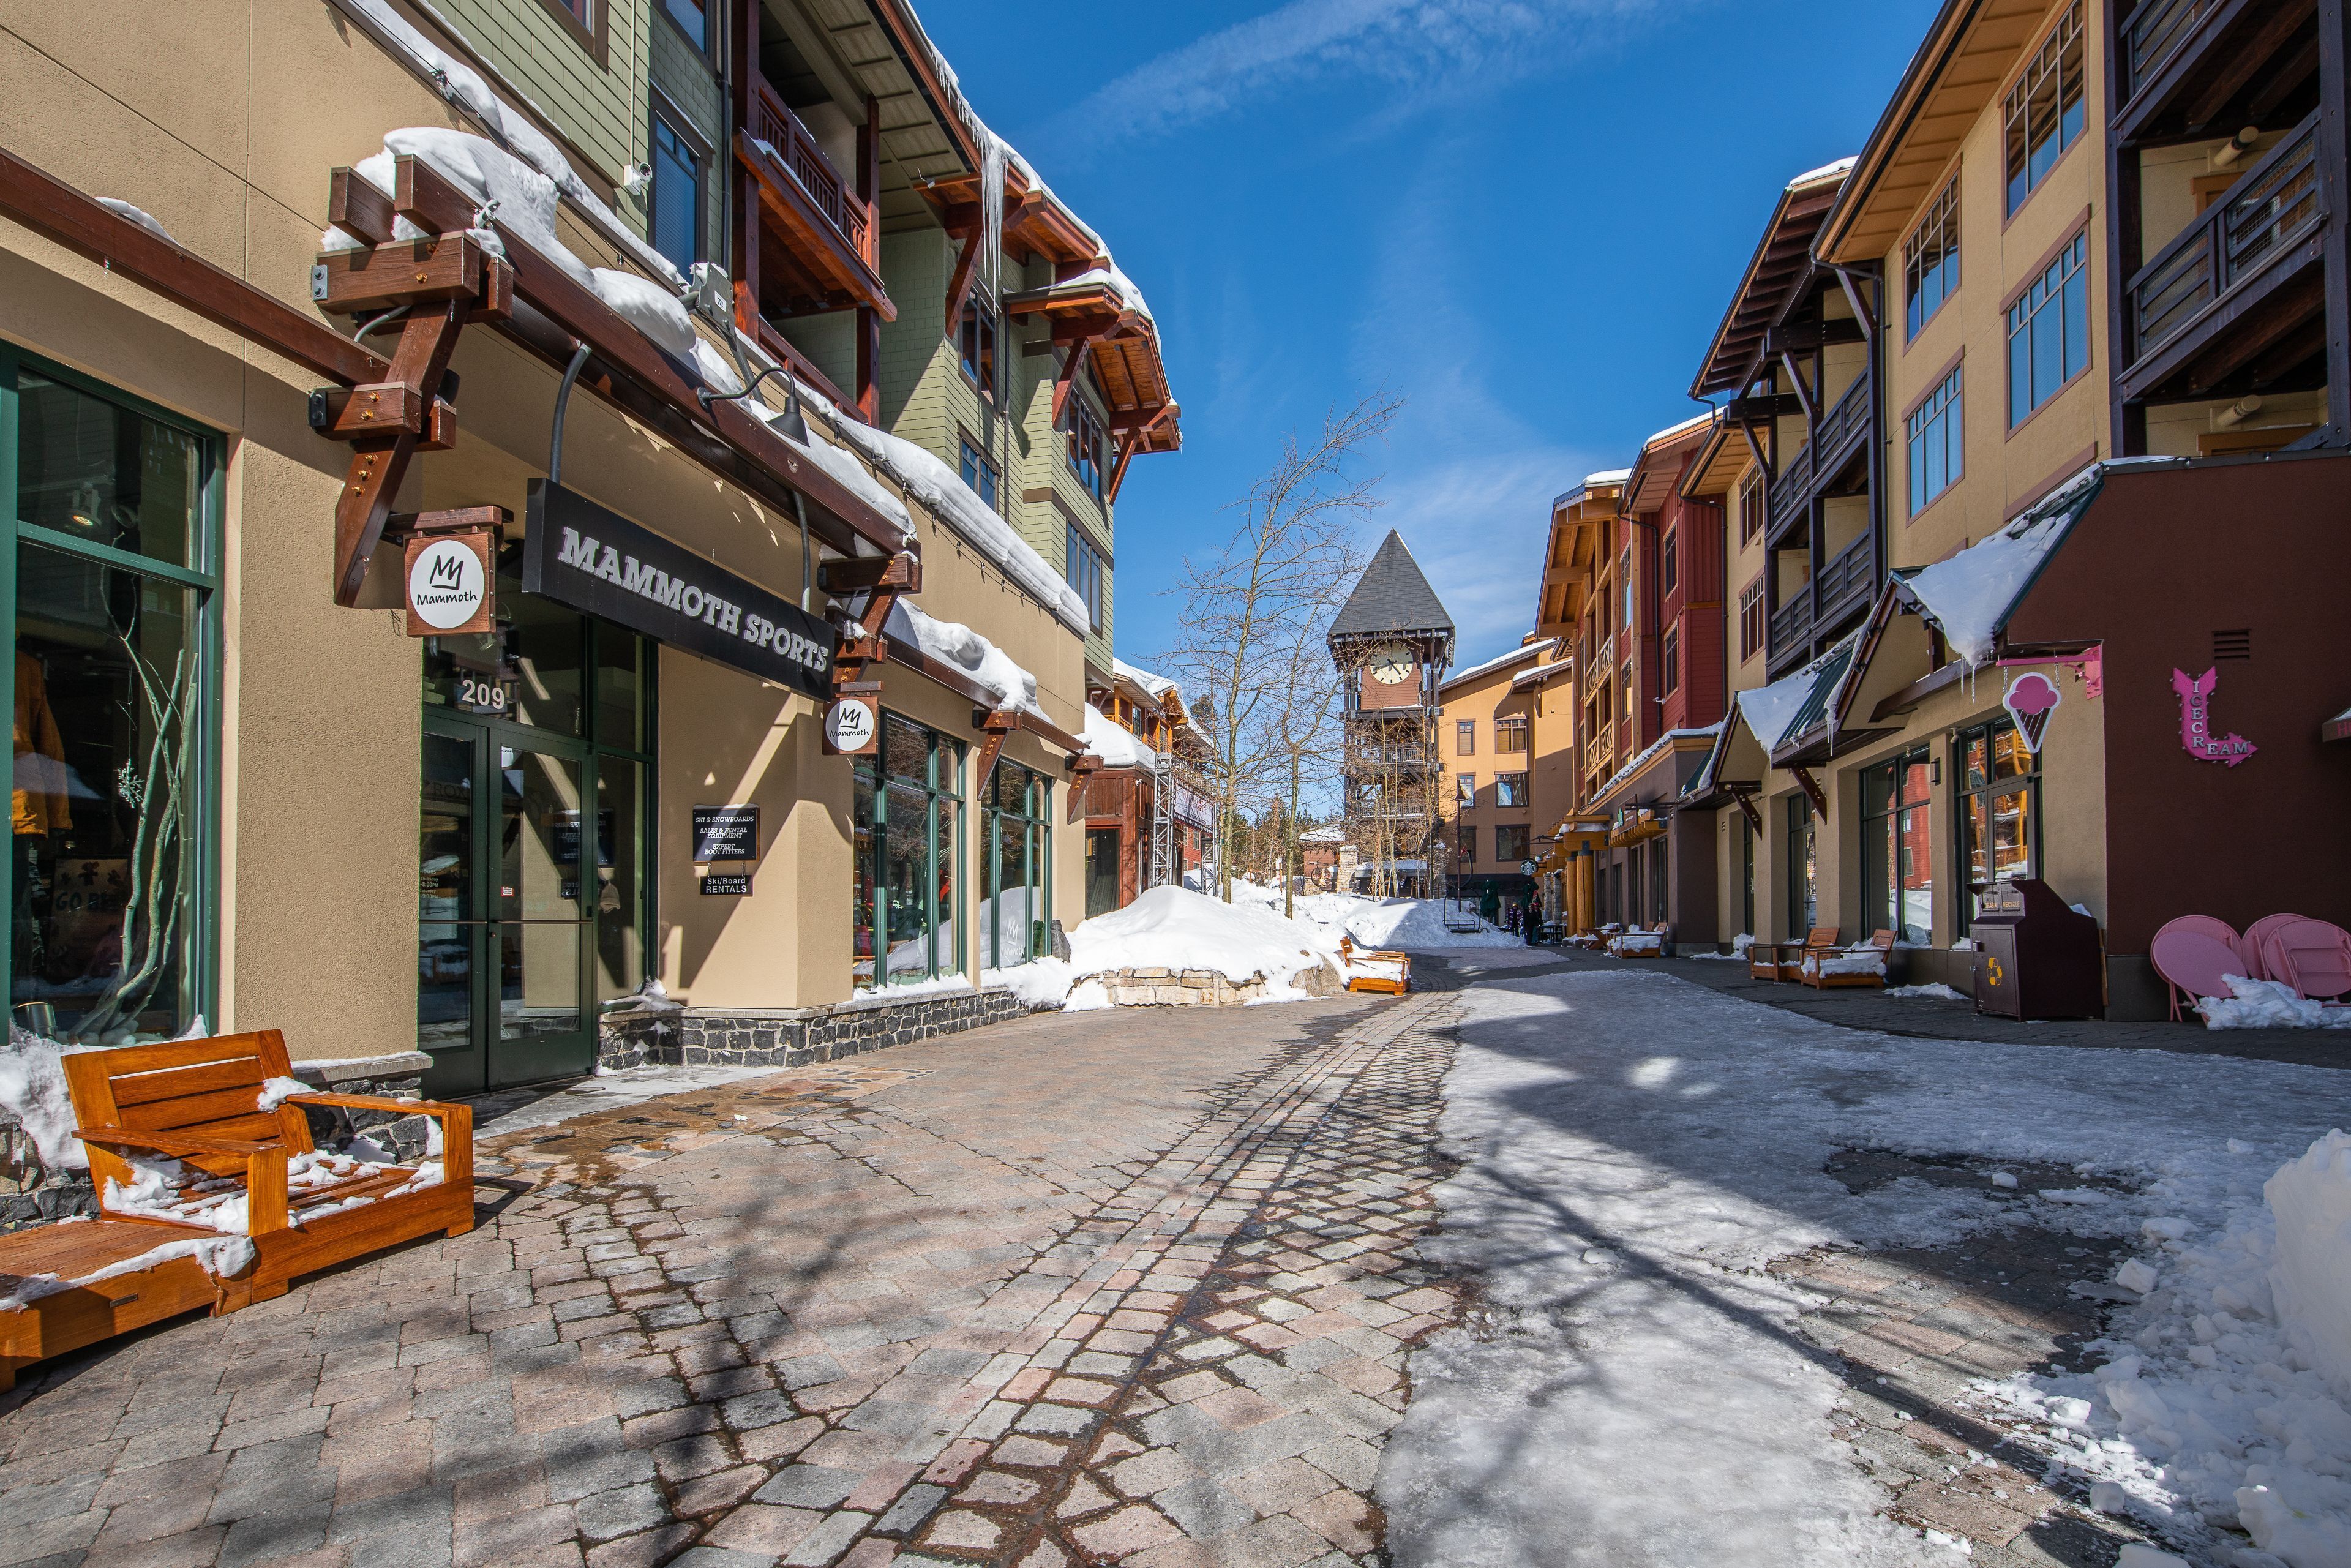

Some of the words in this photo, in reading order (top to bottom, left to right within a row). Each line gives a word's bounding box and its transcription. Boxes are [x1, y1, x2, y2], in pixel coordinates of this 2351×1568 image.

[717, 297, 724, 309] 74
[417, 590, 478, 606] Mammoth
[558, 527, 742, 636] MAMMOTH
[743, 614, 829, 672] SPORTS
[462, 680, 504, 710] 209
[830, 729, 869, 737] Mammoth
